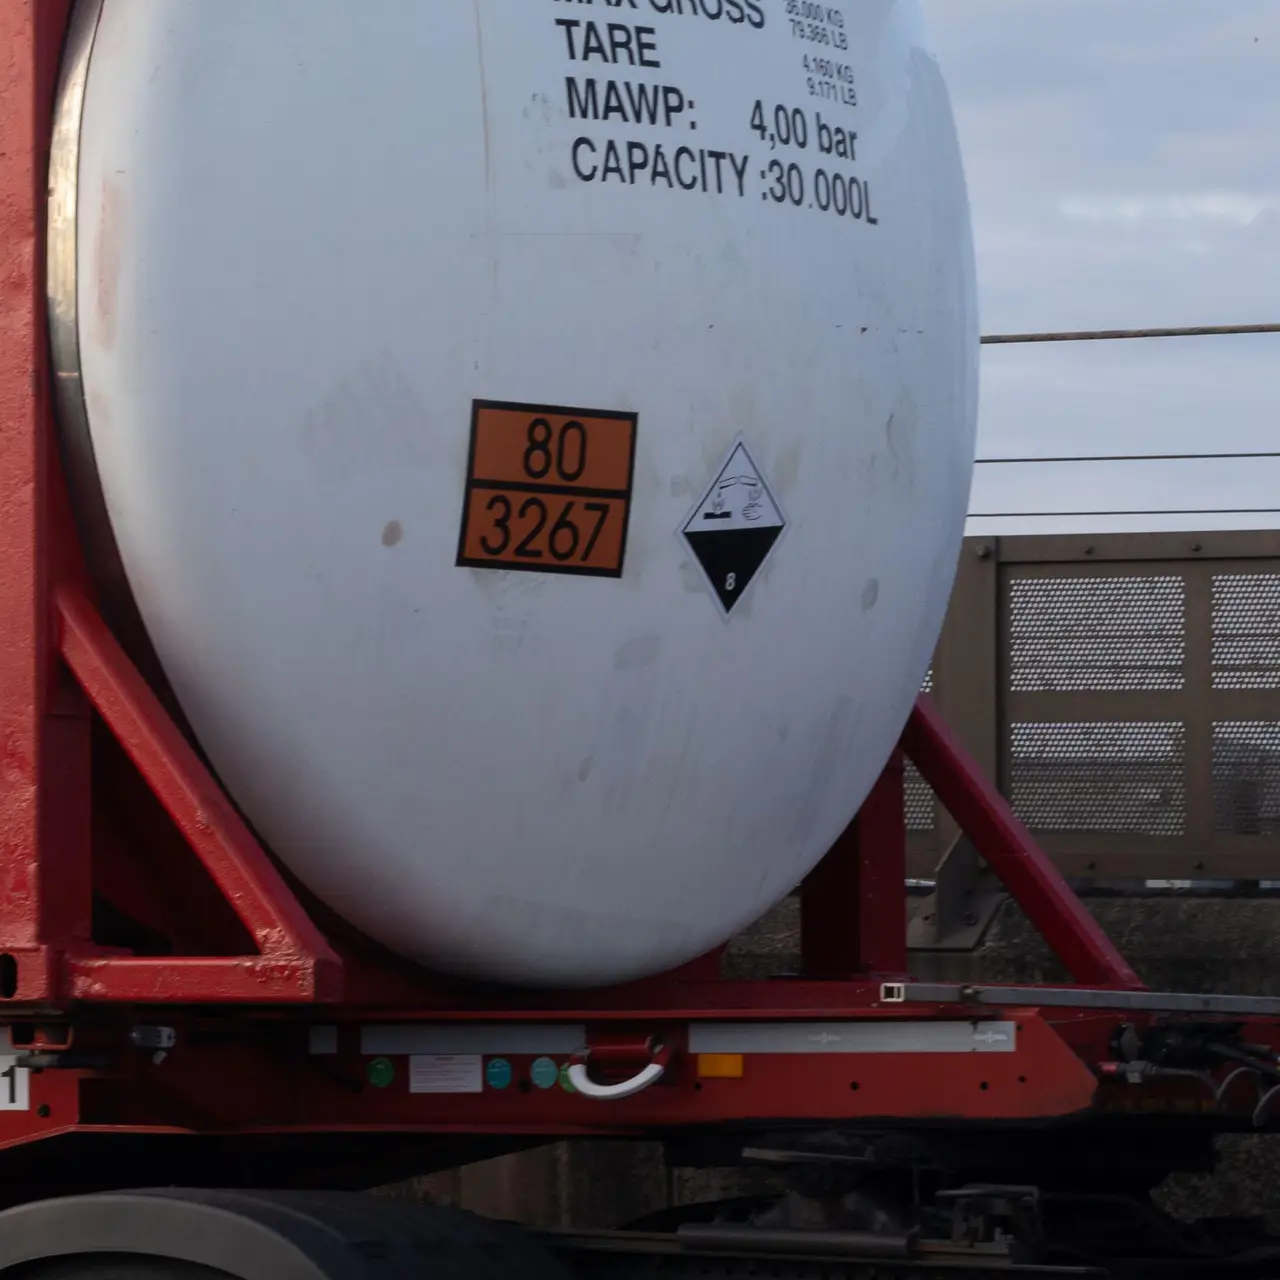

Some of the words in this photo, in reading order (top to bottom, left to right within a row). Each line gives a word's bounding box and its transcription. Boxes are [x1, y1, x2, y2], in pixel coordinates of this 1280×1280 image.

[555, 19, 661, 68] TARE
[831, 30, 848, 51] LB
[565, 77, 697, 130] MAWP:
[749, 100, 808, 151] 4,00
[816, 111, 857, 162] bar
[840, 85, 857, 107] LB
[571, 137, 750, 197] CAPACITY
[522, 418, 588, 483] 80
[479, 495, 611, 562] 3267
[725, 572, 736, 591] 8
